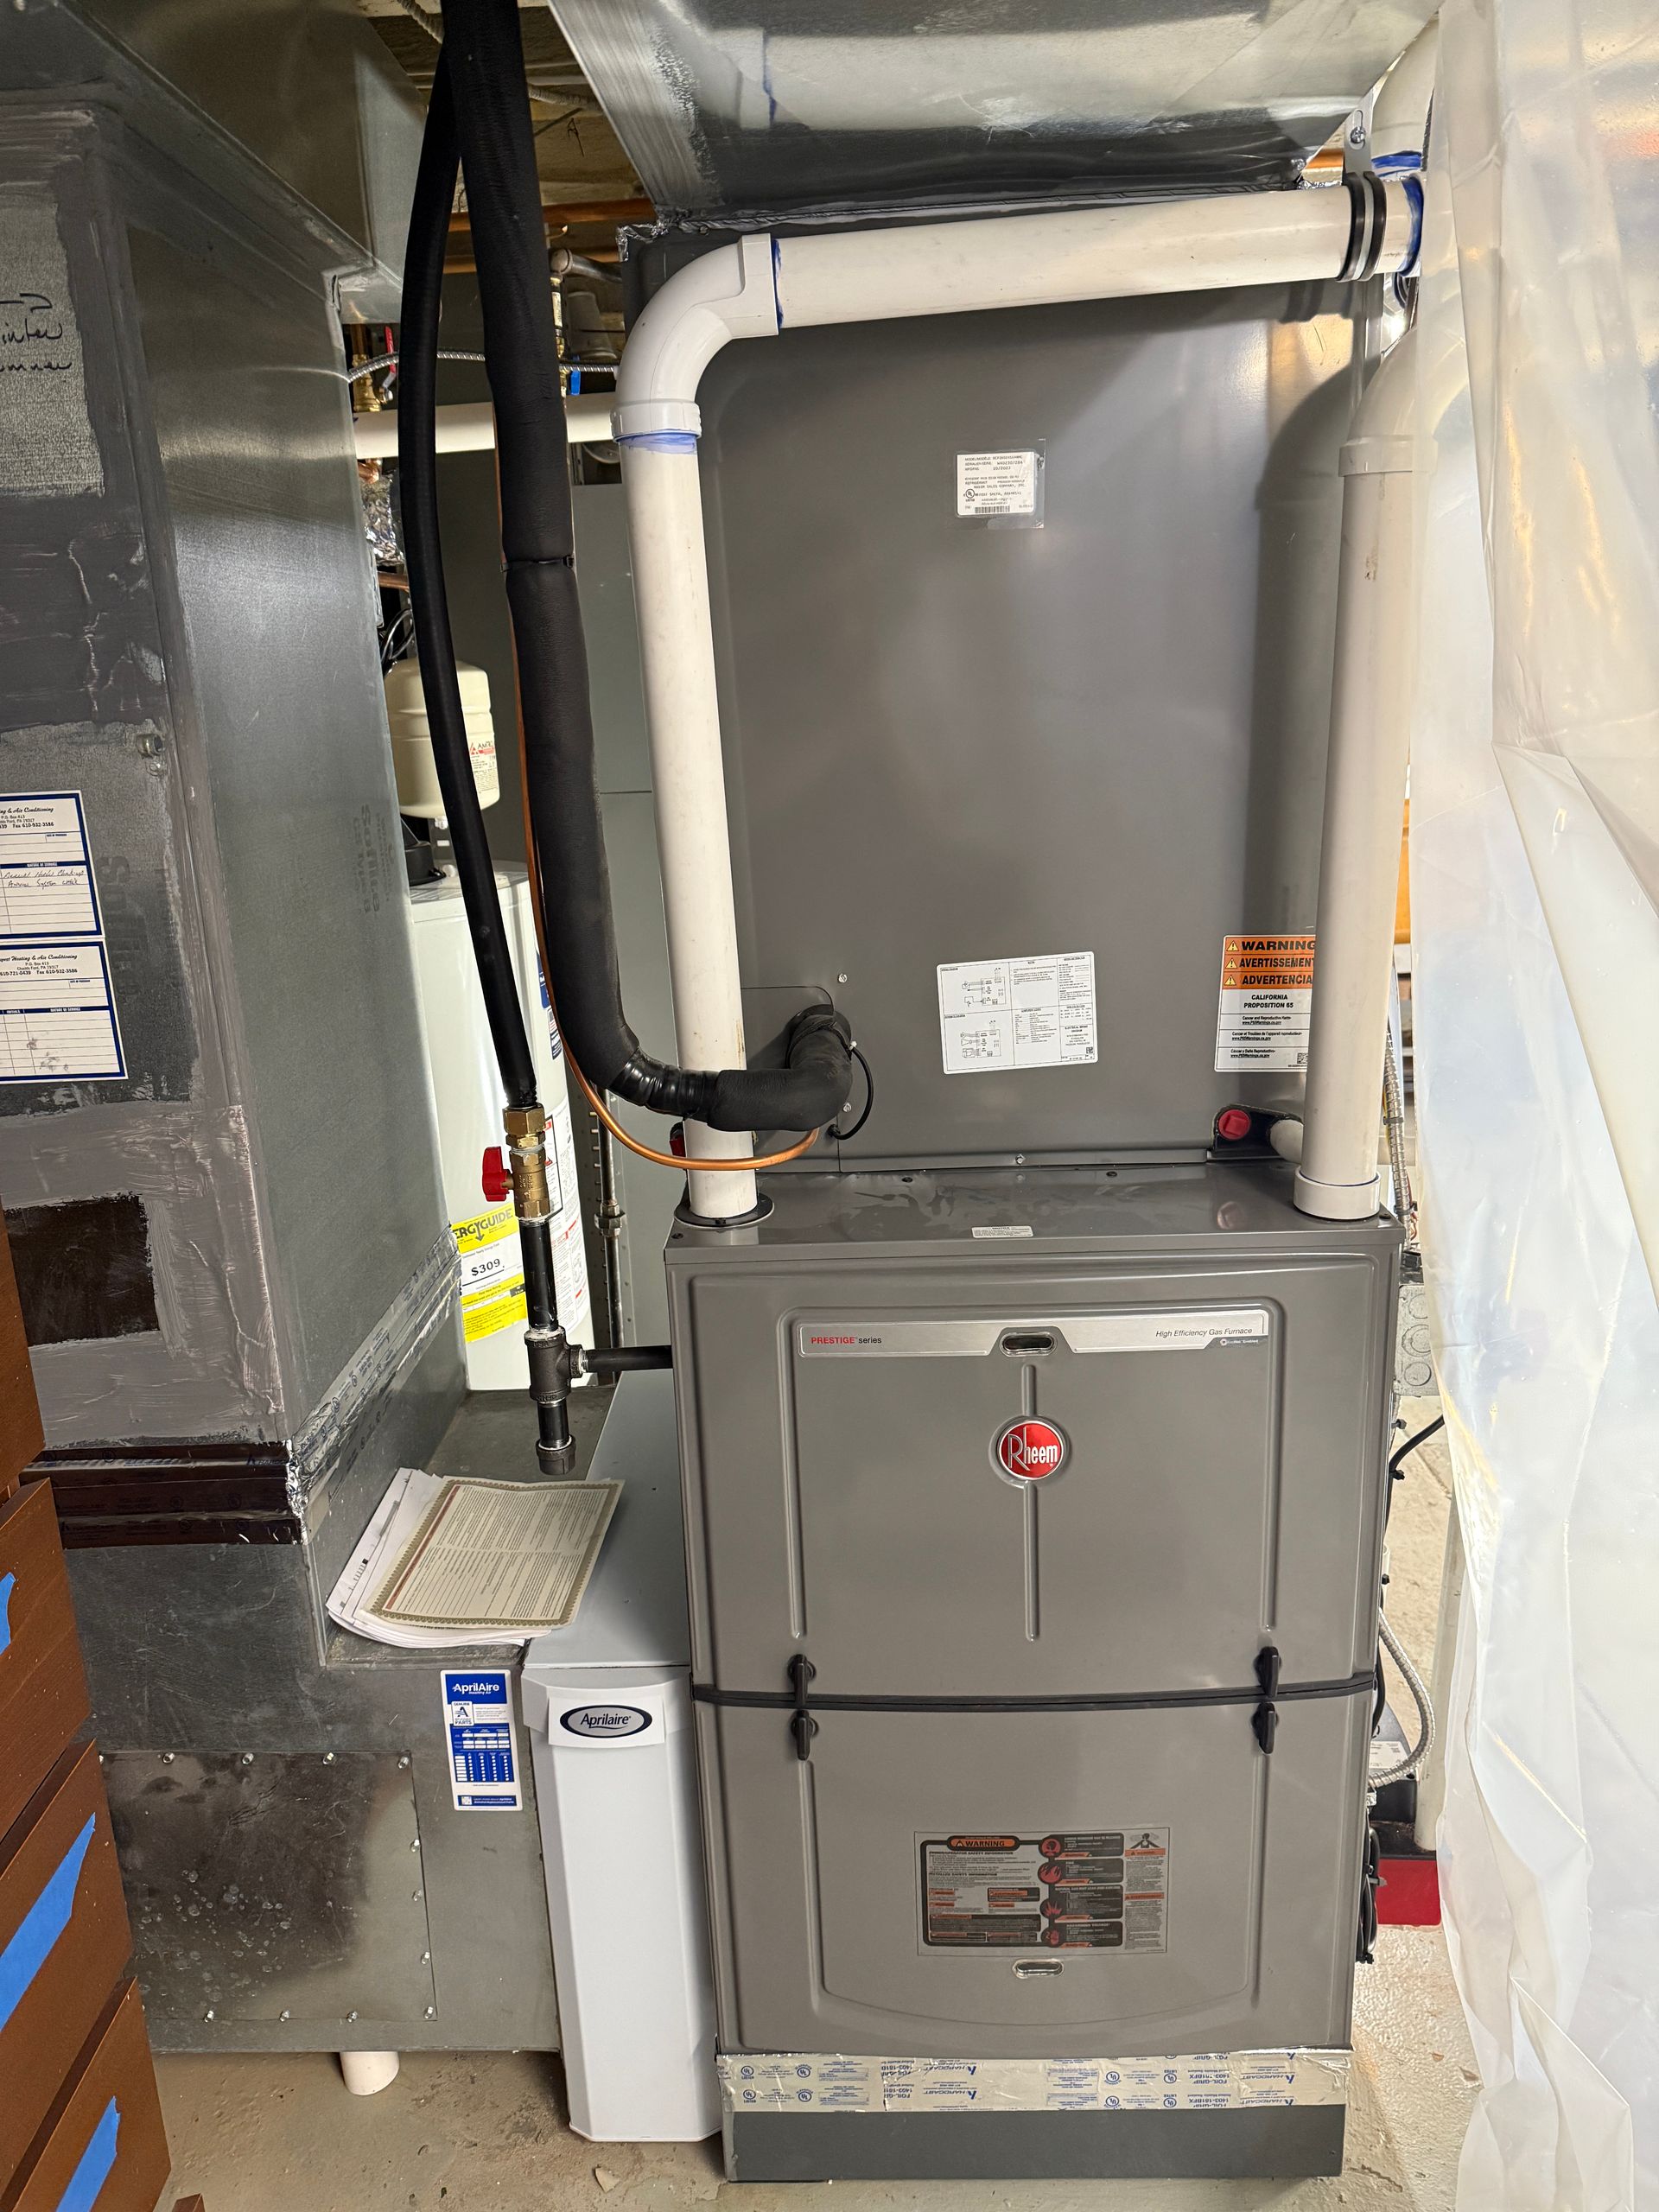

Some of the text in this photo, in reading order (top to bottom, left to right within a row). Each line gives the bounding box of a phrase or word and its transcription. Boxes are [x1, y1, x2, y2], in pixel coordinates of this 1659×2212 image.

[1242, 941, 1315, 950] WARNING
[1242, 975, 1313, 985] ADVERTENCIA
[471, 1258, 500, 1276] $309
[1174, 1329, 1207, 1338] Efficiency
[1008, 1427, 1058, 1471] Rheem
[452, 1682, 499, 1694] AprilAire
